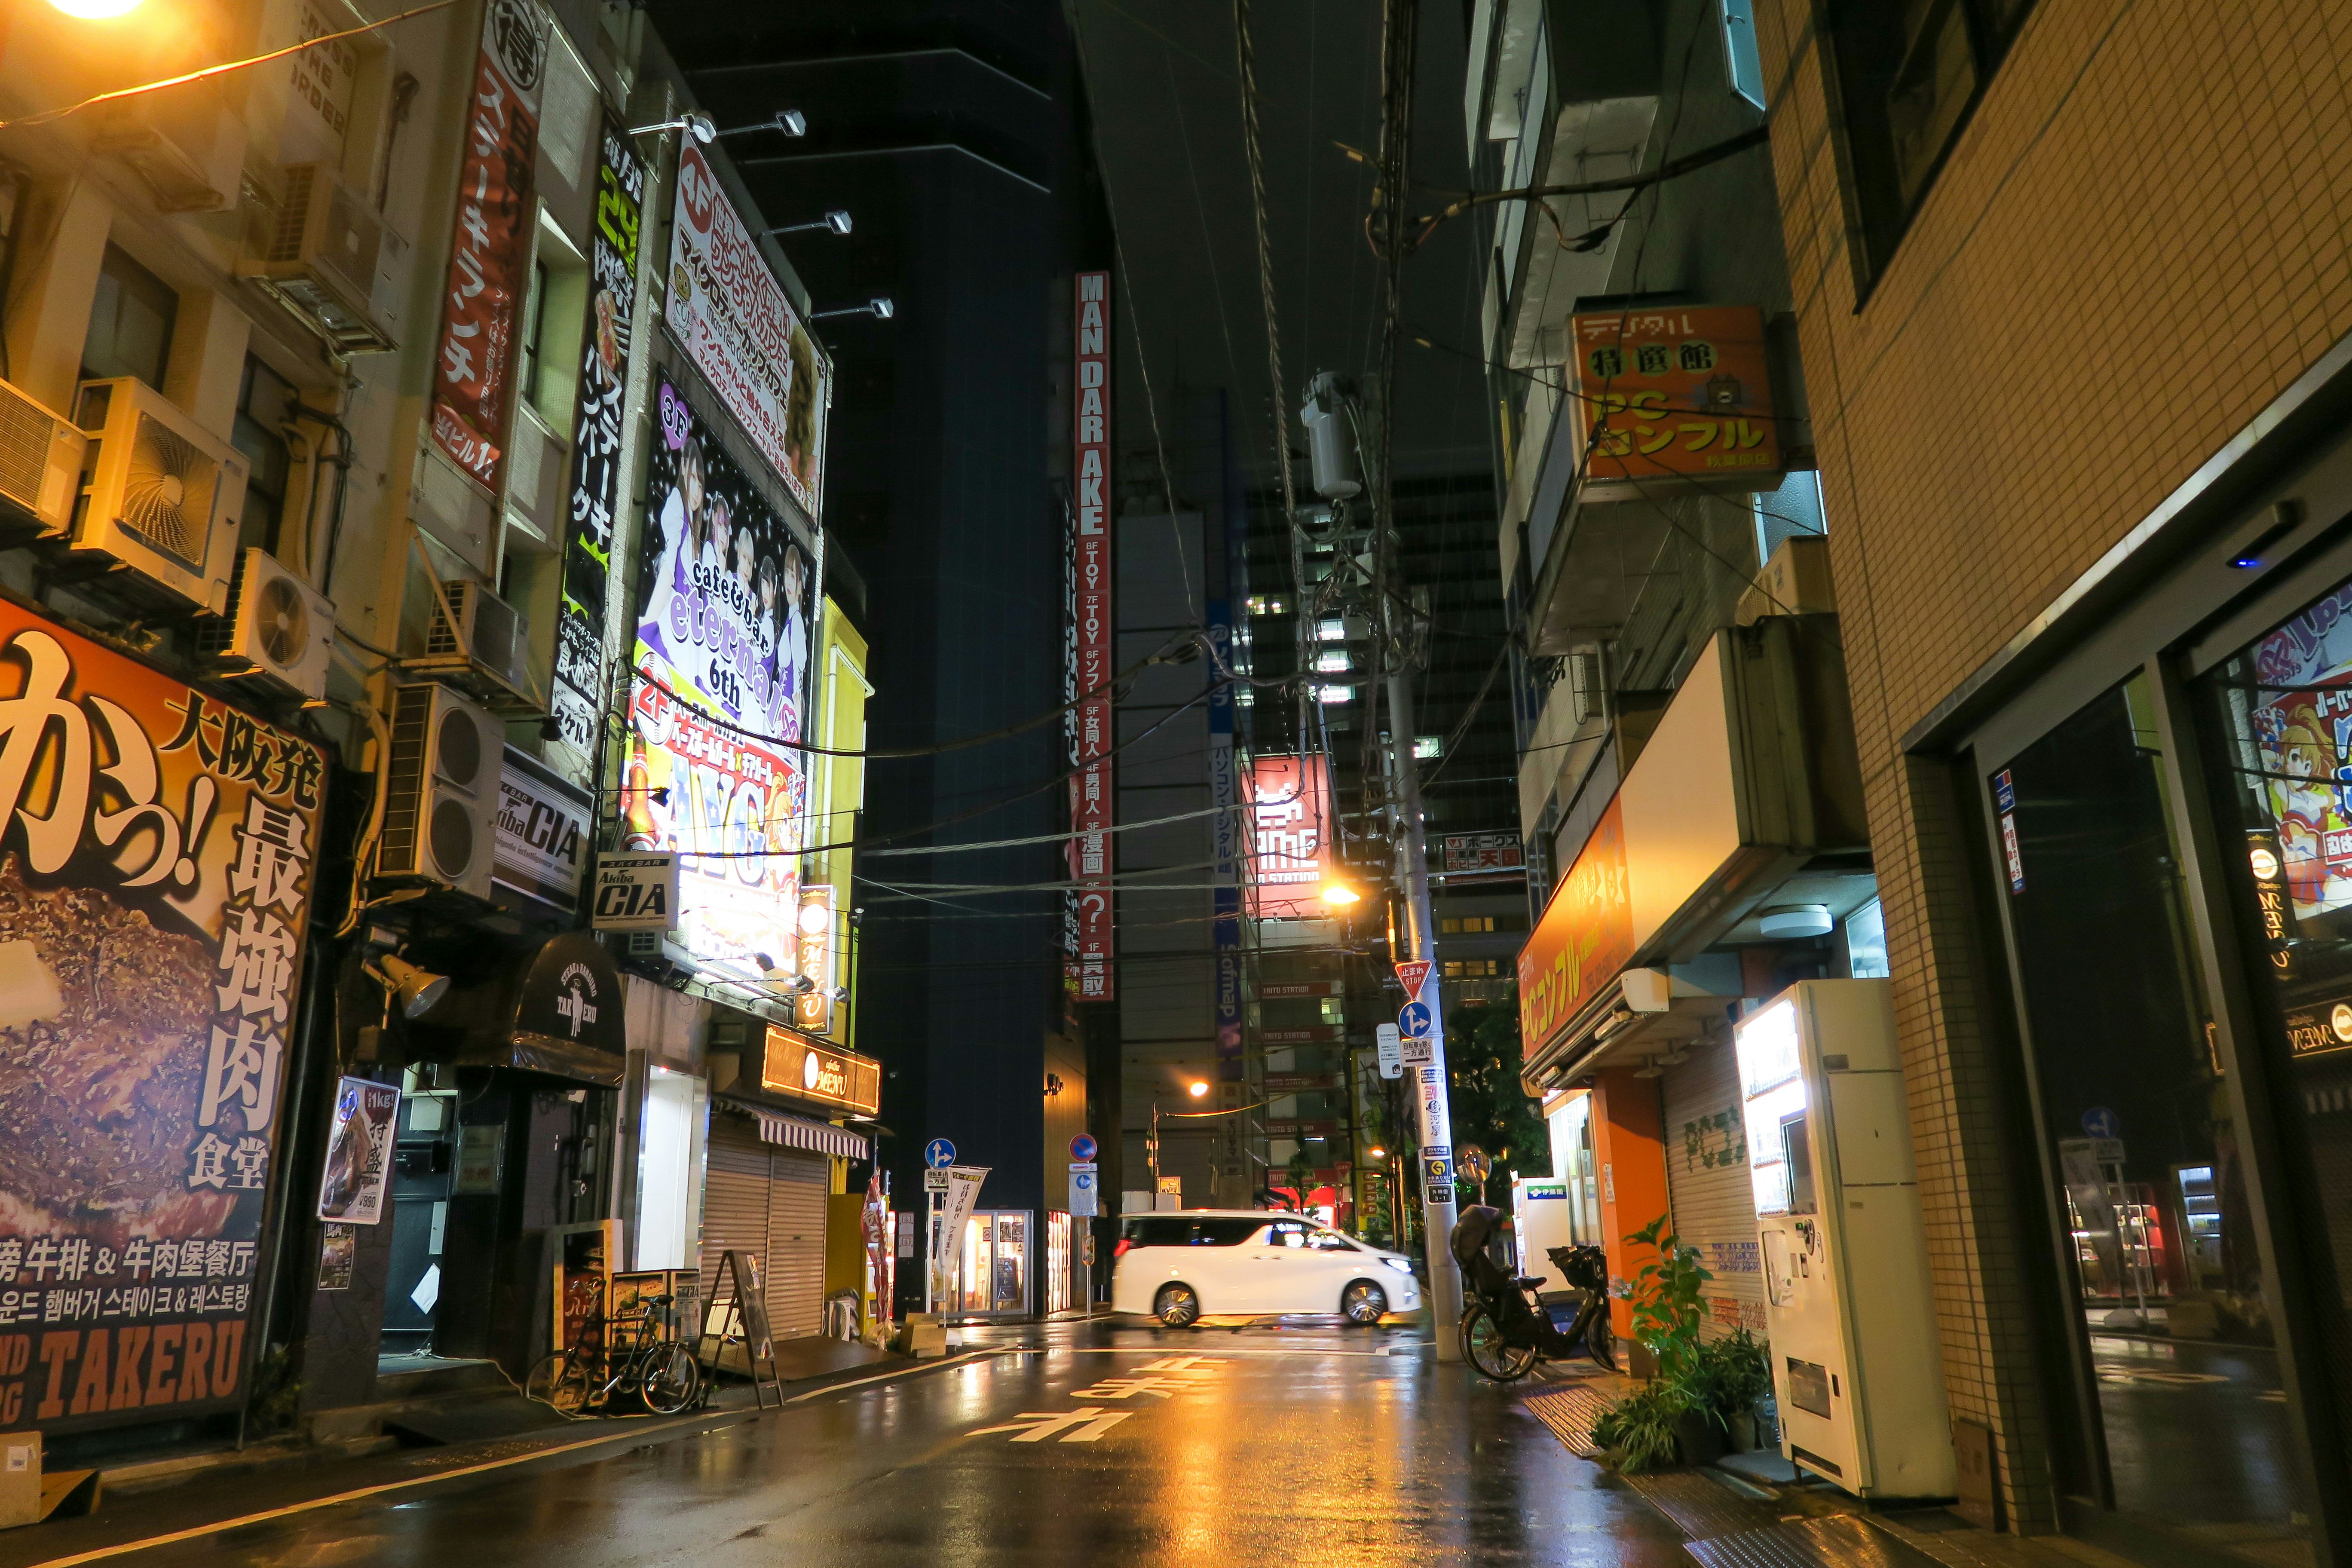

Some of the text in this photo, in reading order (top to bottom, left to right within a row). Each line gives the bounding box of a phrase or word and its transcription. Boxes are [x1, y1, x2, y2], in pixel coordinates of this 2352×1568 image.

[681, 162, 712, 218] 4F
[442, 67, 506, 383] ステーキランチ
[712, 191, 792, 348] 世界一小さく可愛い
[677, 224, 789, 416] マイクロティーカップカフェ
[709, 229, 789, 380] ワンちゃんカフェ
[662, 397, 687, 441] 3F
[1081, 275, 1104, 536] MANDARAKE
[1592, 390, 1669, 422] PC
[572, 344, 602, 521] ハンバーグ
[591, 369, 622, 545] ステーキ
[1086, 542, 1098, 550] 8F
[1085, 550, 1099, 589] TOY
[1086, 596, 1098, 604] 7F
[1085, 604, 1099, 644] TOY
[670, 587, 782, 732] eternal
[1086, 650, 1099, 659] 6F
[637, 663, 673, 724] 2F
[710, 658, 742, 714] 6th
[1086, 707, 1099, 716] 5F
[159, 688, 324, 811] 大阪発
[1085, 716, 1100, 757] 女同人
[1086, 764, 1099, 772] 4F
[510, 790, 528, 803] BAR
[1085, 773, 1100, 815] 男同人
[524, 800, 580, 865] CIA
[1086, 822, 1099, 830] 3F
[1468, 835, 1519, 848] ボークス
[598, 872, 634, 884] Akiba
[595, 883, 666, 917] CIA
[1088, 942, 1099, 951] 1F
[1081, 952, 1105, 997] 買取
[1282, 986, 1309, 994] STATION
[1402, 967, 1424, 977] 止まれ
[1406, 976, 1422, 985] STOP
[1283, 1031, 1311, 1039] STATION
[1403, 1040, 1431, 1050] 自転車を除く
[1403, 1048, 1432, 1057] 一方通行
[816, 1069, 848, 1096] MENU
[94, 1246, 118, 1276] &
[44, 1288, 101, 1323] 햄버거
[102, 1286, 172, 1318] 스테이크
[174, 1287, 187, 1313] &
[189, 1283, 250, 1314] 레스토랑
[37, 1320, 246, 1420] TAKERU
